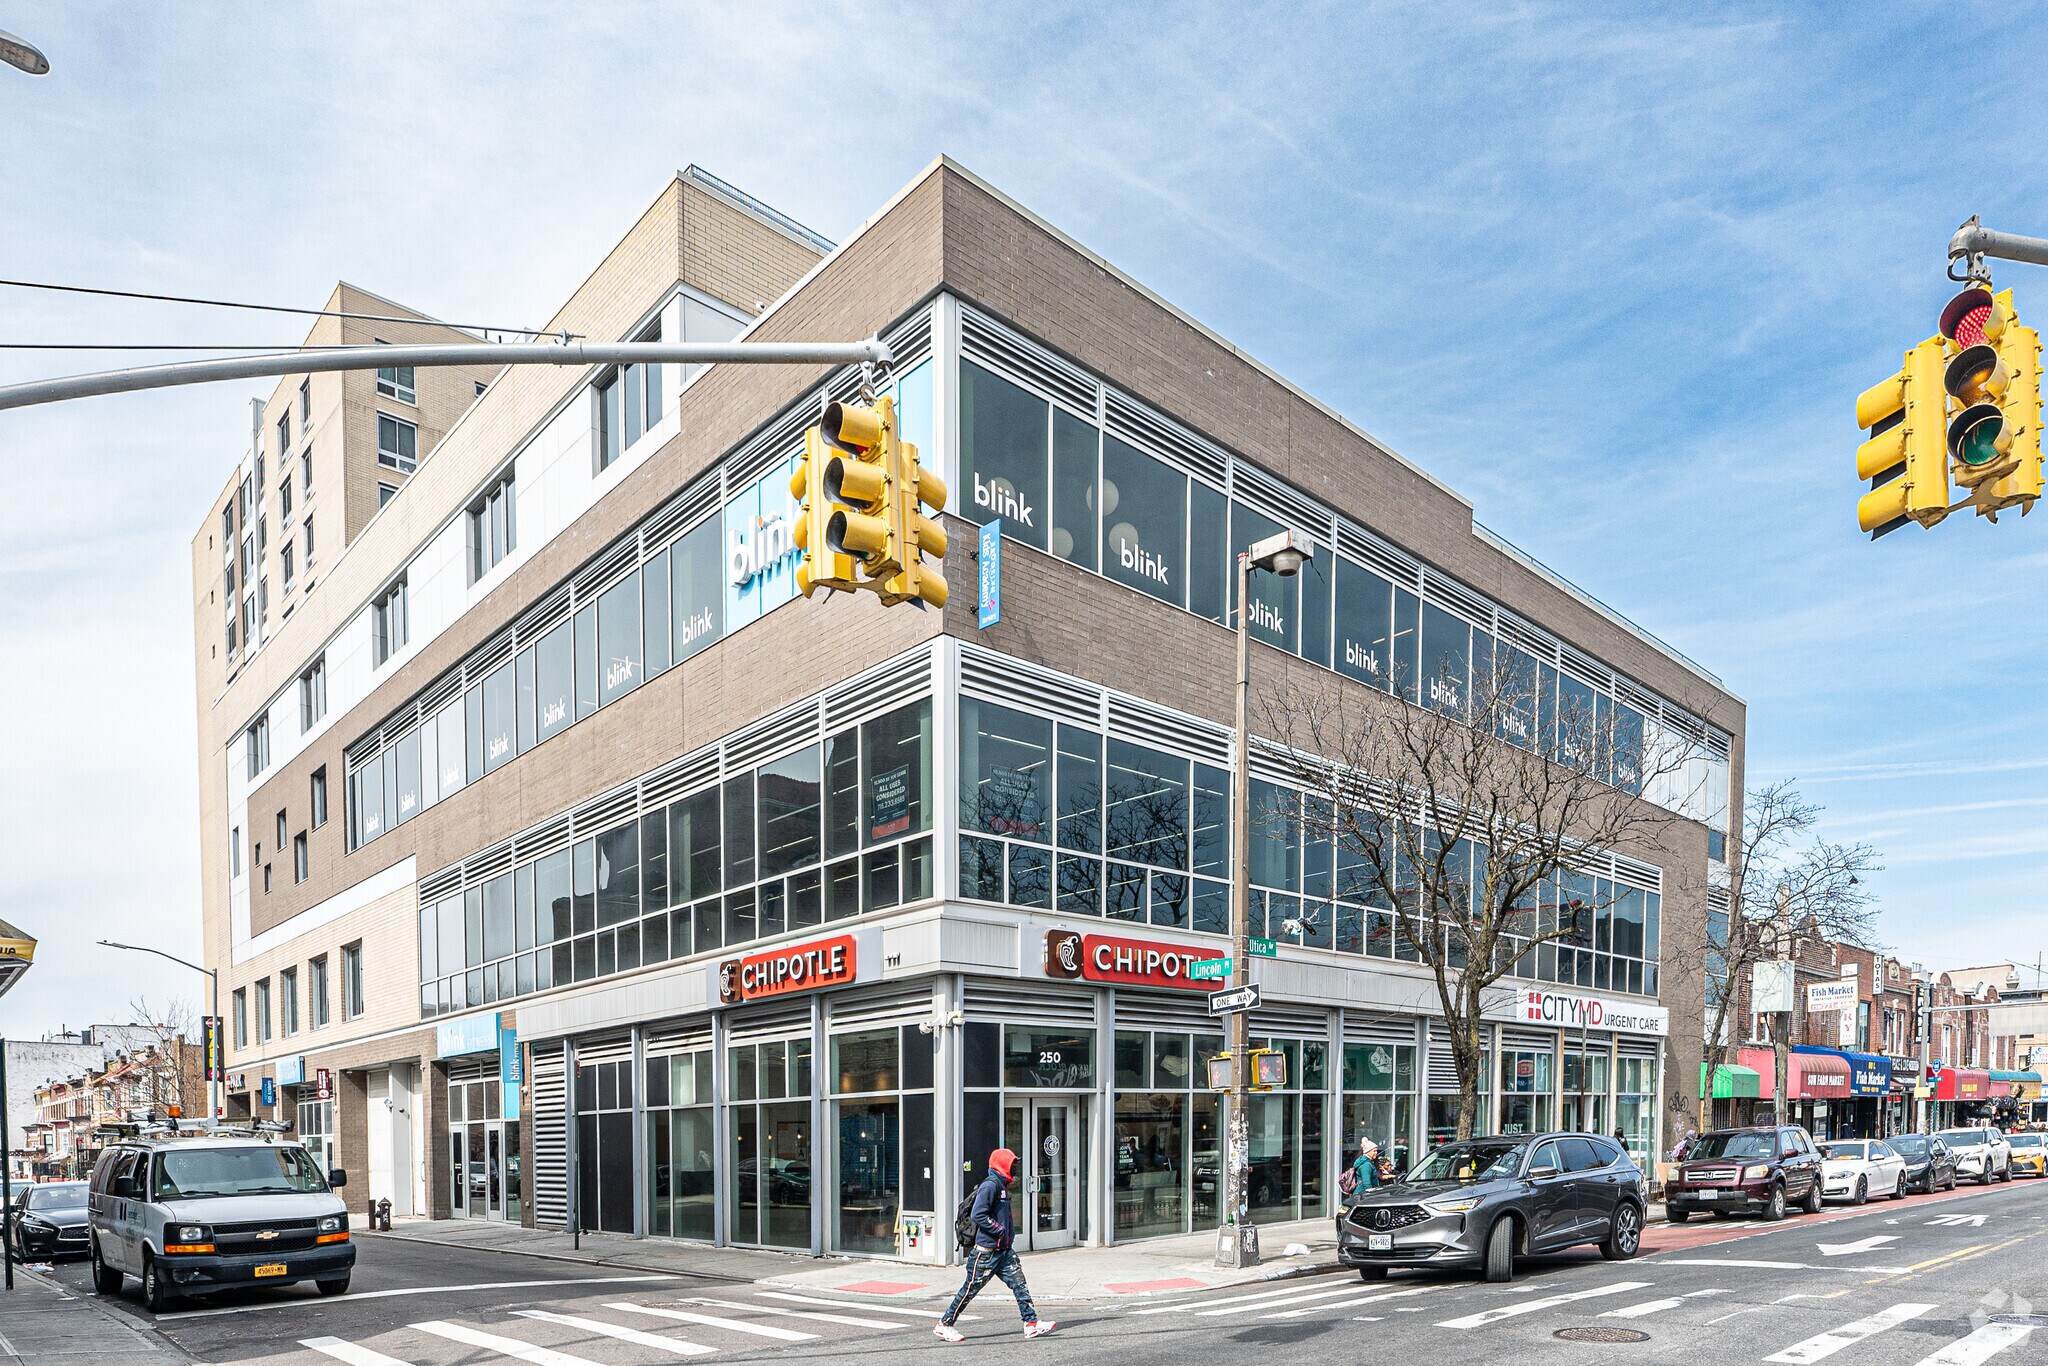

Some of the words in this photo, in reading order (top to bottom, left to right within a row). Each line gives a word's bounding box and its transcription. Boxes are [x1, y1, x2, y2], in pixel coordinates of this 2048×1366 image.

[974, 471, 1034, 528] blink
[1120, 537, 1169, 585] blink
[682, 606, 713, 646] blink
[1346, 638, 1378, 674] blink
[607, 656, 633, 690] blink
[1430, 676, 1458, 709] blink
[544, 698, 566, 728] blink
[1502, 711, 1527, 738] blink
[489, 732, 509, 761] blink
[443, 763, 460, 788] blink
[879, 784, 888, 793] ALL
[889, 779, 901, 788] USES
[1000, 778, 1012, 786] ALL
[401, 790, 416, 813] blink
[876, 785, 906, 802] CONSIDERED
[366, 813, 379, 834] blink
[1249, 938, 1267, 954] Utica
[741, 945, 847, 989] CHIPOTLE
[1094, 944, 1223, 982] CHIPOT
[1195, 961, 1222, 978] Lincoln
[1216, 997, 1231, 1008] ONE
[1237, 993, 1252, 1003] WAY
[1811, 987, 1827, 997] Fish
[1828, 986, 1854, 996] Market
[1542, 994, 1603, 1026] CITYMD
[1604, 1013, 1637, 1029] URGENT
[1639, 1017, 1659, 1031] CARE
[442, 1024, 465, 1051] blink
[510, 1059, 520, 1081] blink
[1040, 1051, 1061, 1064] 250
[1502, 1123, 1523, 1135] JUST
